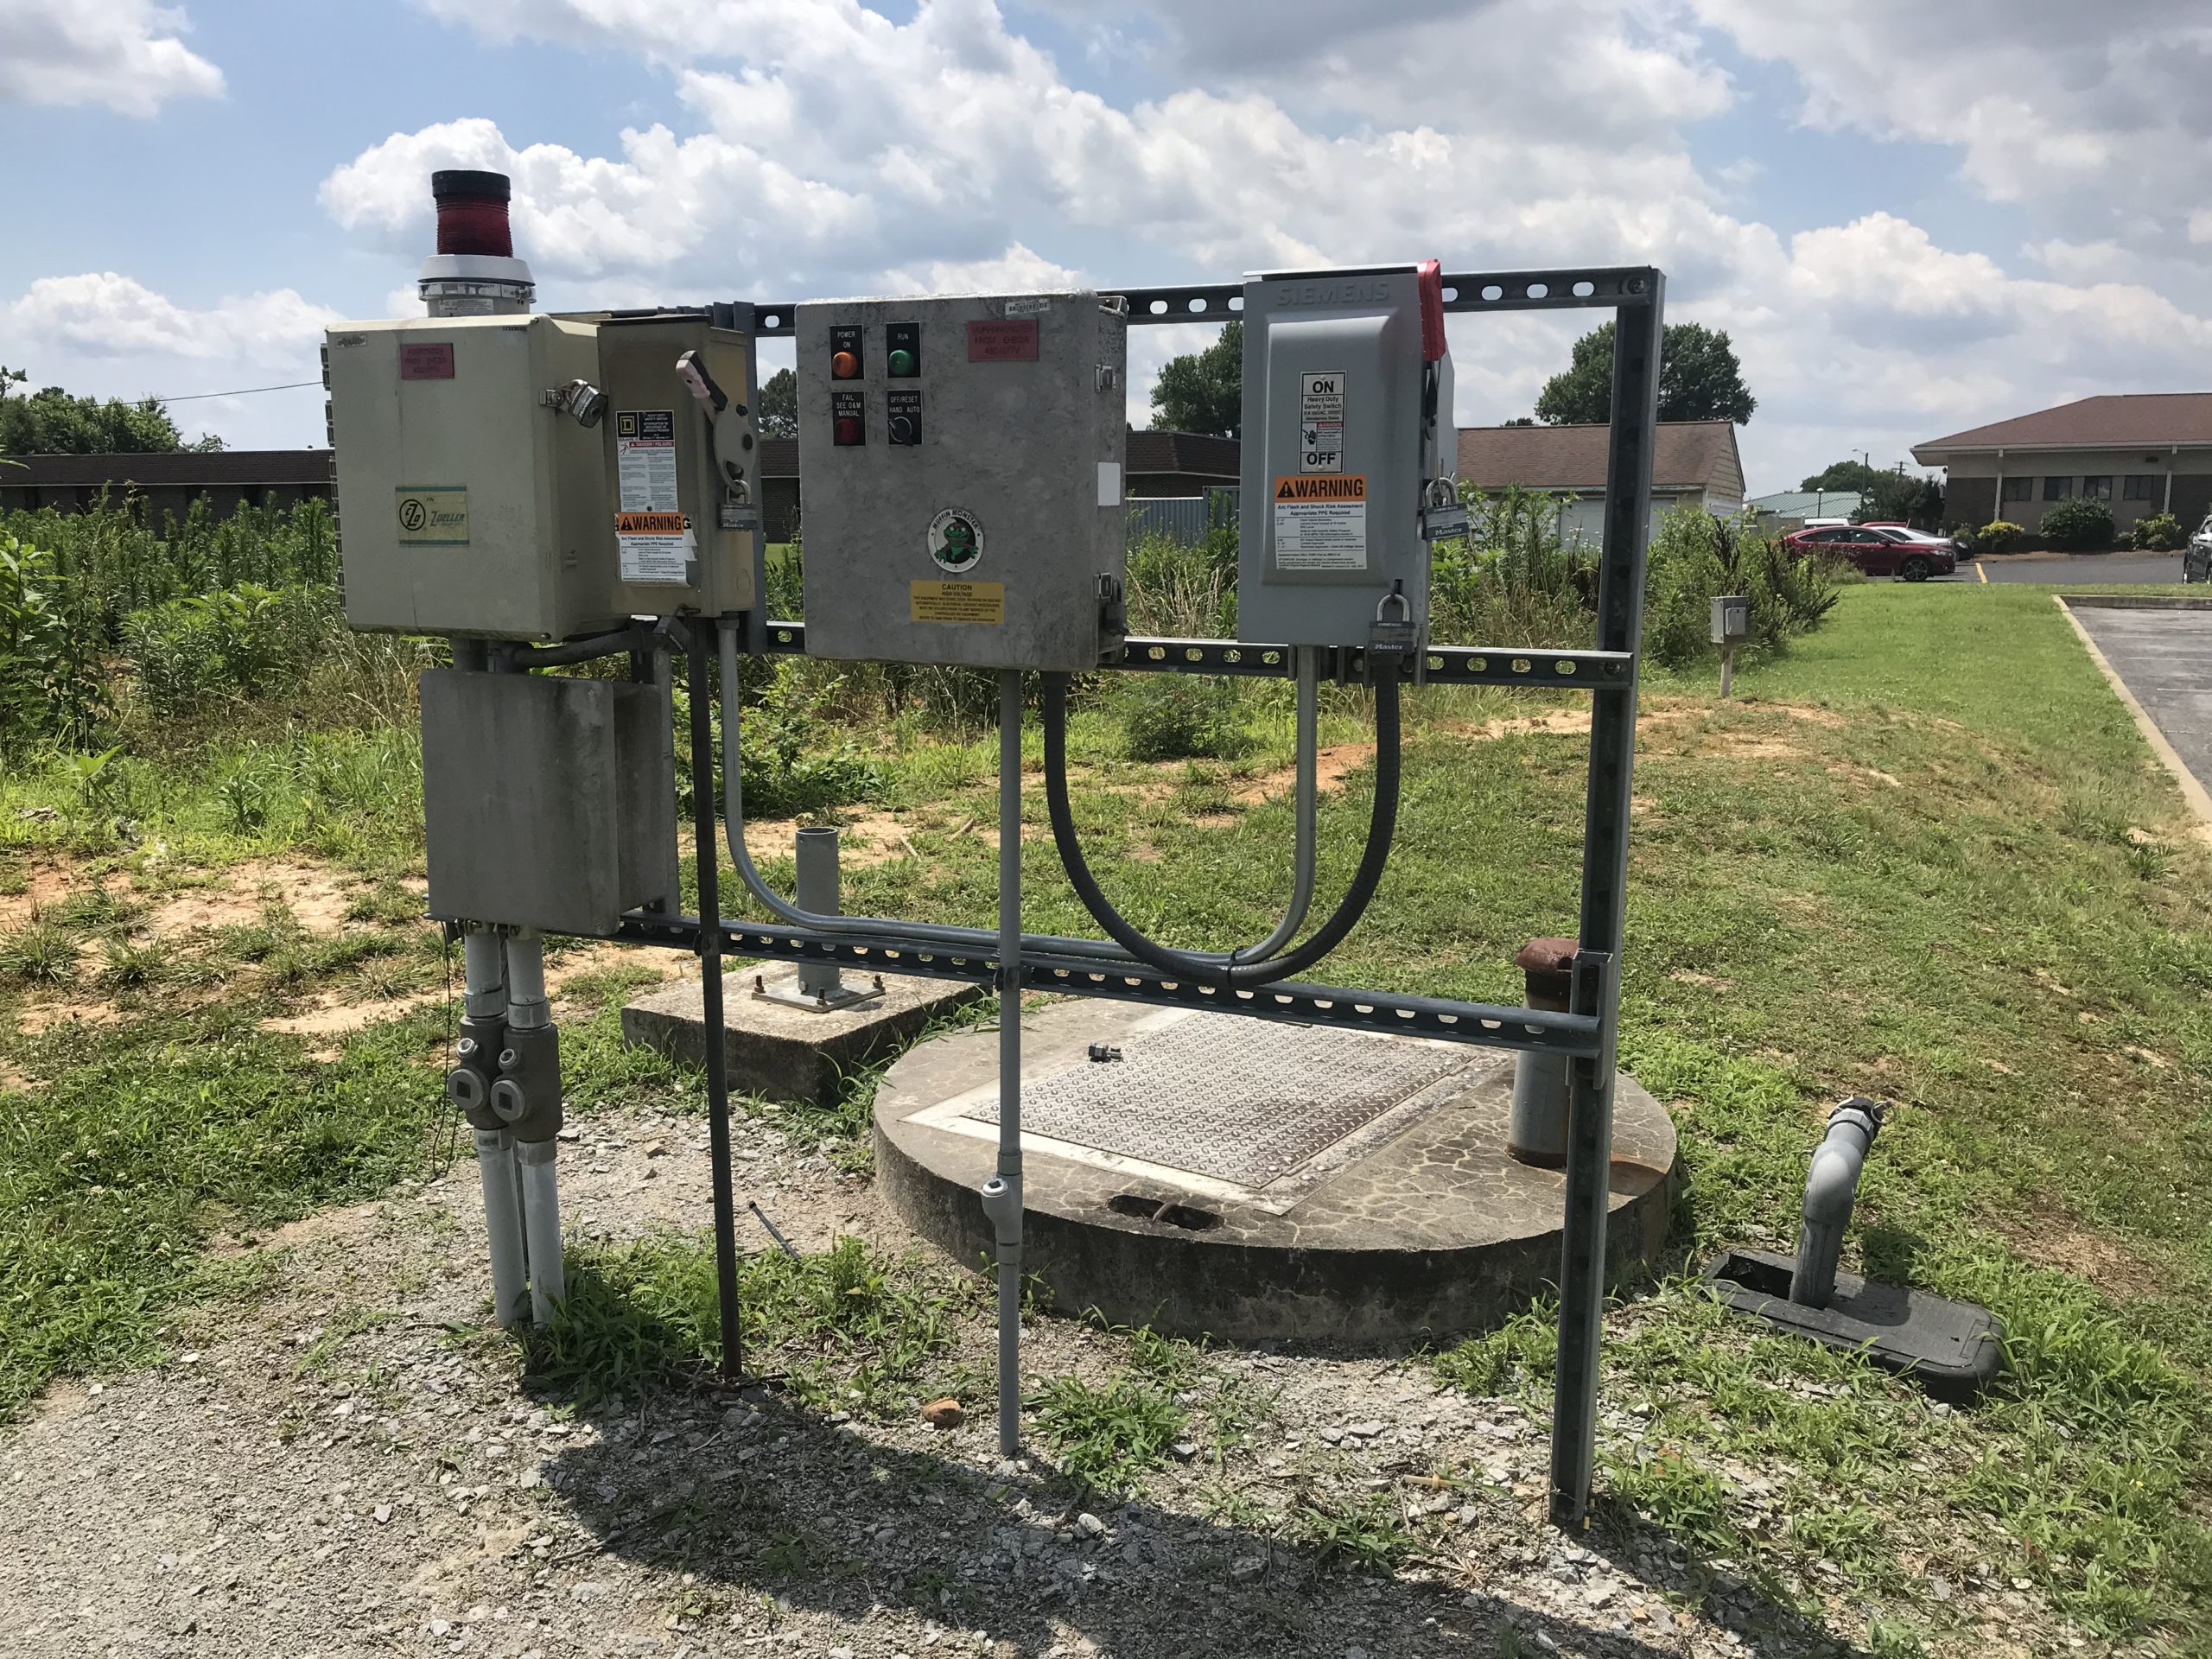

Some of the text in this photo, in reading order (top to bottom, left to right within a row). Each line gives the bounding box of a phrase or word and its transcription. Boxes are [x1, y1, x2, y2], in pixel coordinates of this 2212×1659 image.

[1277, 282, 1389, 306] SIEMENS
[1313, 381, 1334, 393] ON
[1306, 453, 1336, 465] OFF
[1295, 479, 1363, 497] WARNING
[632, 516, 681, 531] WARNING
[932, 510, 979, 529] MUFFIN MONSTER
